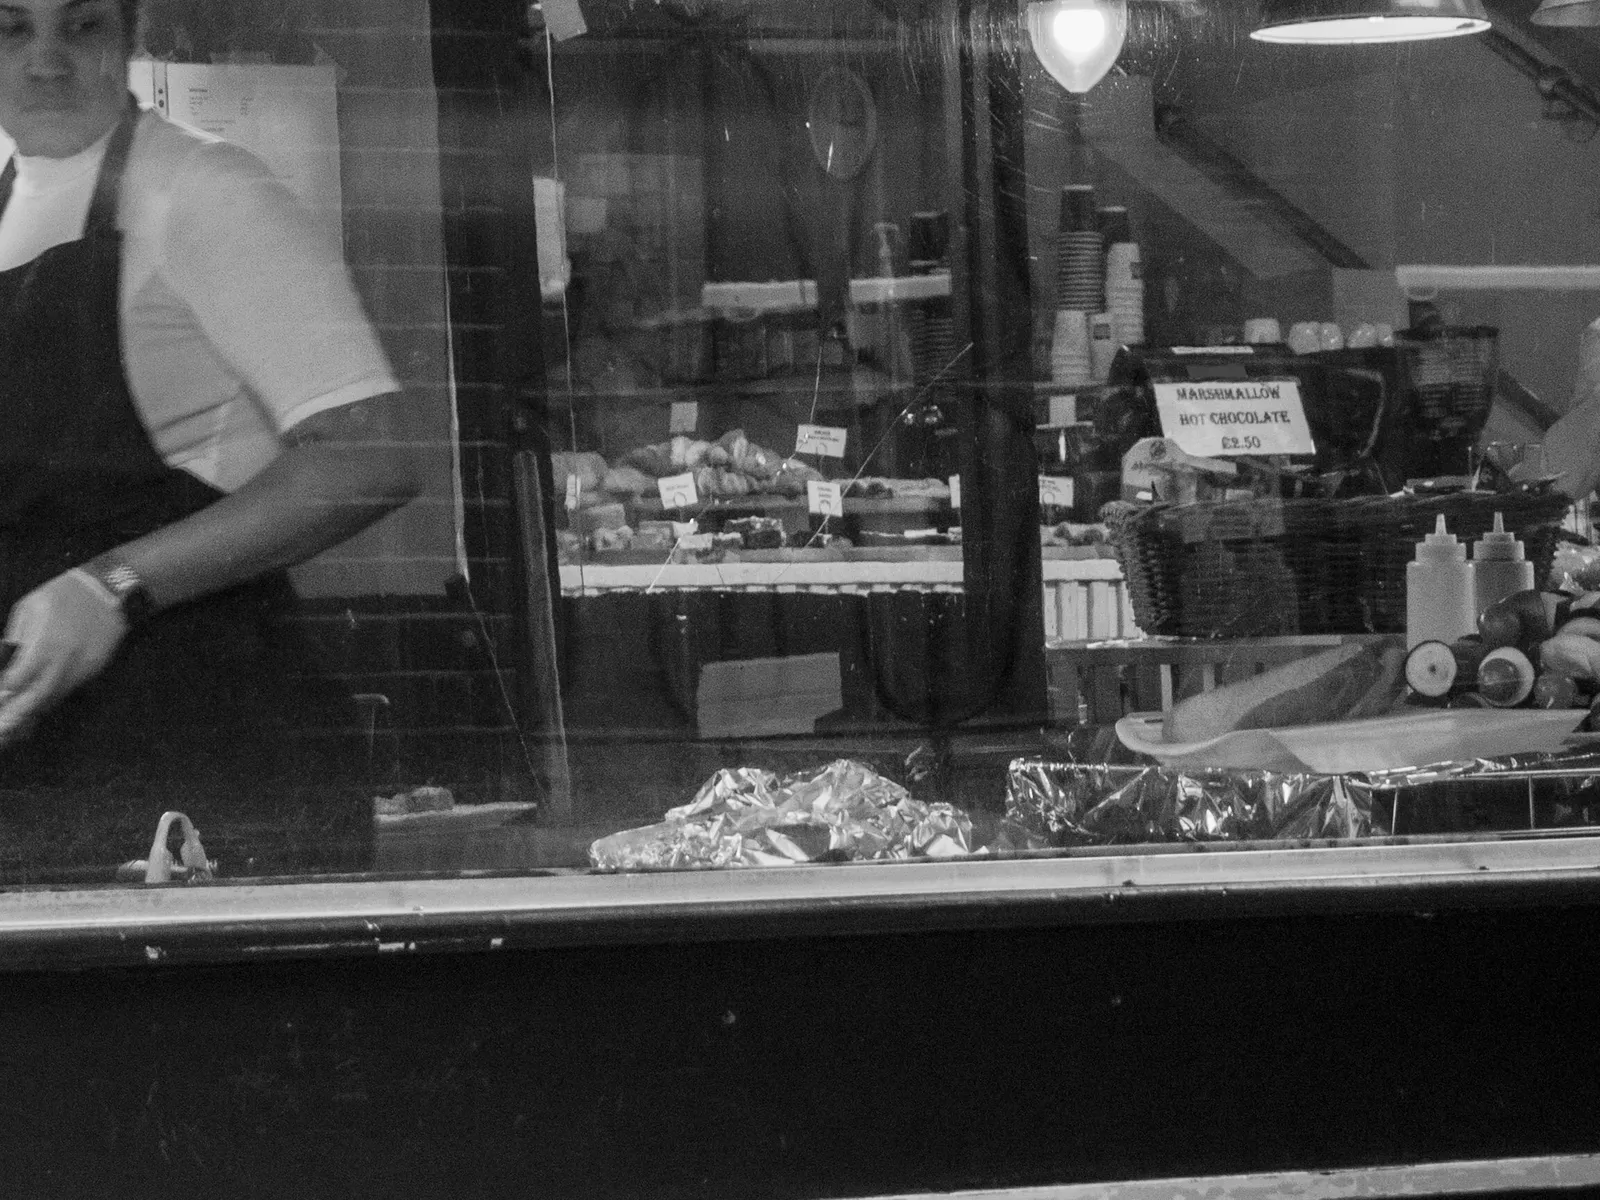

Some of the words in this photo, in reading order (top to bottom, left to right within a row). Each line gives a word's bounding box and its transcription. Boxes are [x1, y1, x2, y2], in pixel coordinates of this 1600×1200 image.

[1176, 385, 1281, 400] MARSHMALLOW
[1179, 413, 1207, 426] HOT
[1210, 411, 1291, 425] CHOCOLATE
